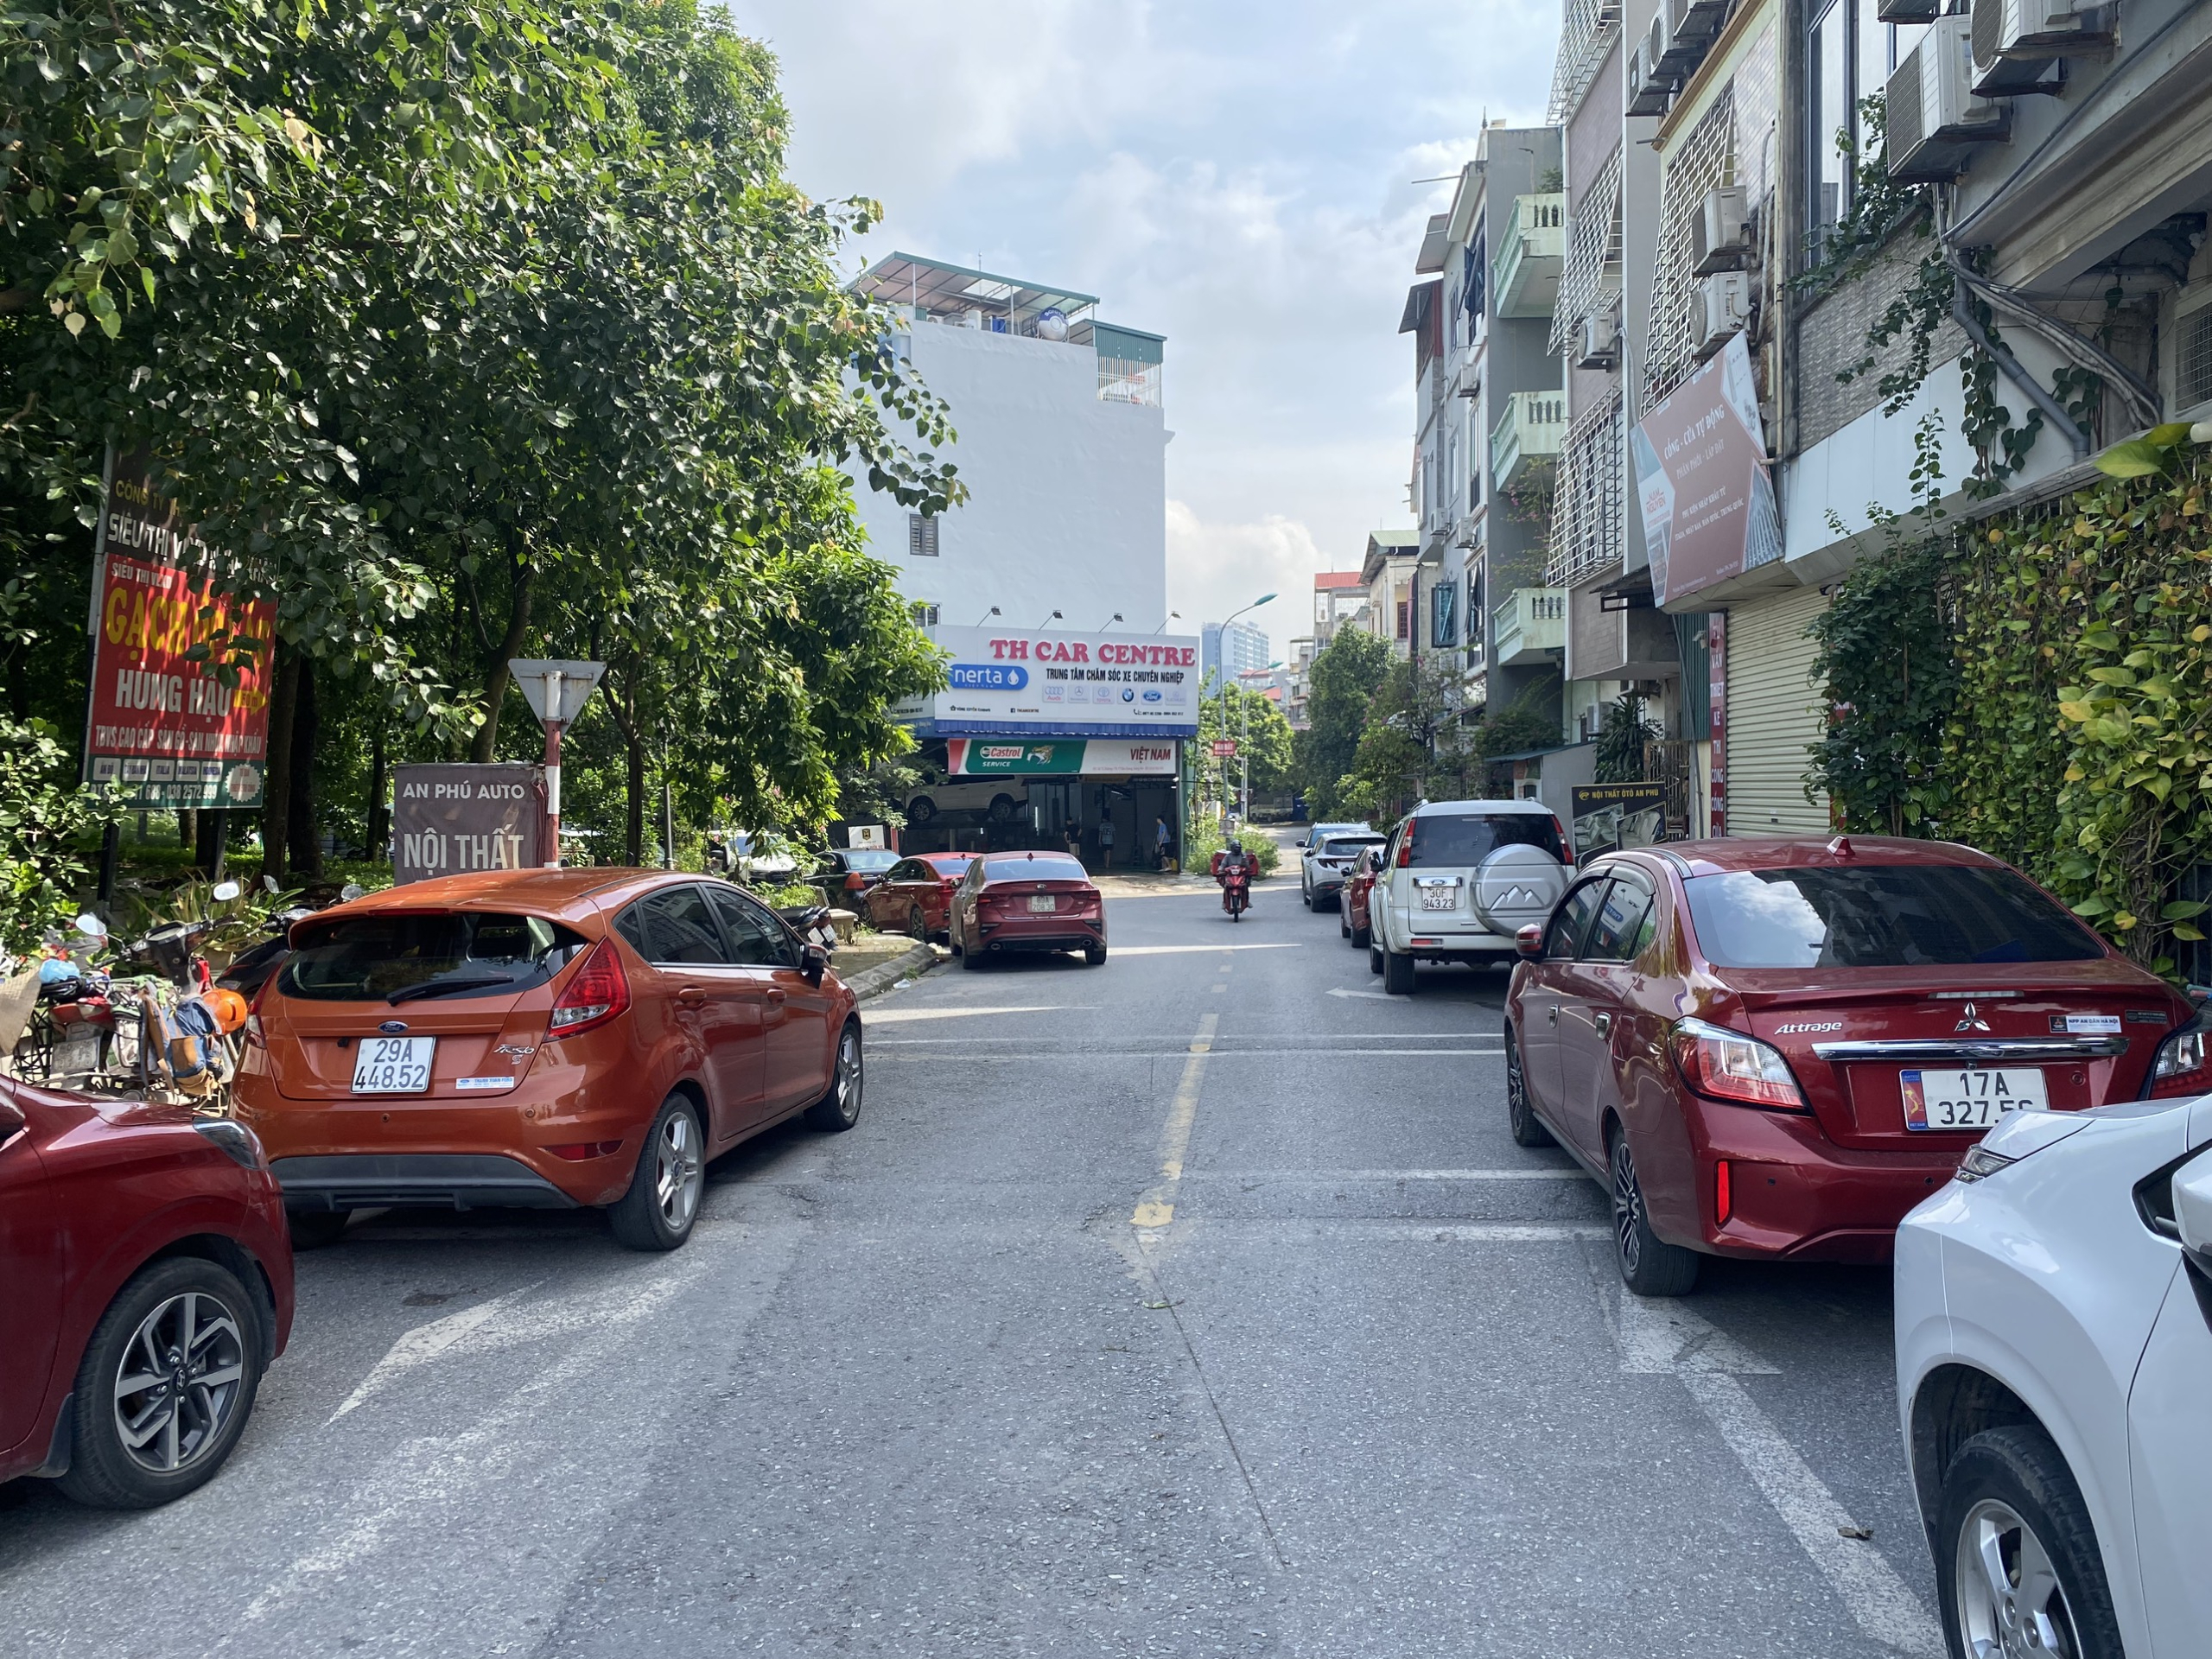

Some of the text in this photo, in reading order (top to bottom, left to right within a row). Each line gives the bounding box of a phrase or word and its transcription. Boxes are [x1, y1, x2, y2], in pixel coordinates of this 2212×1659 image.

[1706, 404, 1725, 429] ĐỘNG
[115, 478, 149, 505] CÔNG
[107, 512, 144, 549] SIÊU
[145, 525, 169, 562] THỊ
[111, 560, 134, 580] SIÊU
[136, 568, 150, 588] THỊ
[106, 587, 188, 661] GẠCH
[989, 639, 1196, 667] TH CAR CENTRE
[954, 667, 1002, 684] nerta
[1046, 666, 1185, 685] TRUNG TÂM CHĂM SÓC XE CHUYÊN NGHIỆP
[188, 672, 232, 723] HẬU
[118, 727, 135, 747] CAO
[137, 721, 154, 749] CẤP
[990, 747, 1021, 758] Castrol
[1130, 746, 1172, 764] VIỆT NAM
[182, 785, 202, 800] 2572
[203, 784, 218, 800] 999
[403, 779, 525, 799] AN PHÚ AUTO
[1592, 789, 1603, 799] NỘI
[1605, 788, 1619, 798] THẤT
[1635, 788, 1644, 797] AN
[1645, 786, 1659, 797] PHÚ
[404, 823, 524, 876] NỘI THẤT
[1429, 887, 1447, 899] 30F
[1774, 1021, 1842, 1035] Attrage
[373, 1039, 413, 1063] 29A
[354, 1065, 427, 1090] 448.52
[1960, 1071, 2010, 1096] 17A
